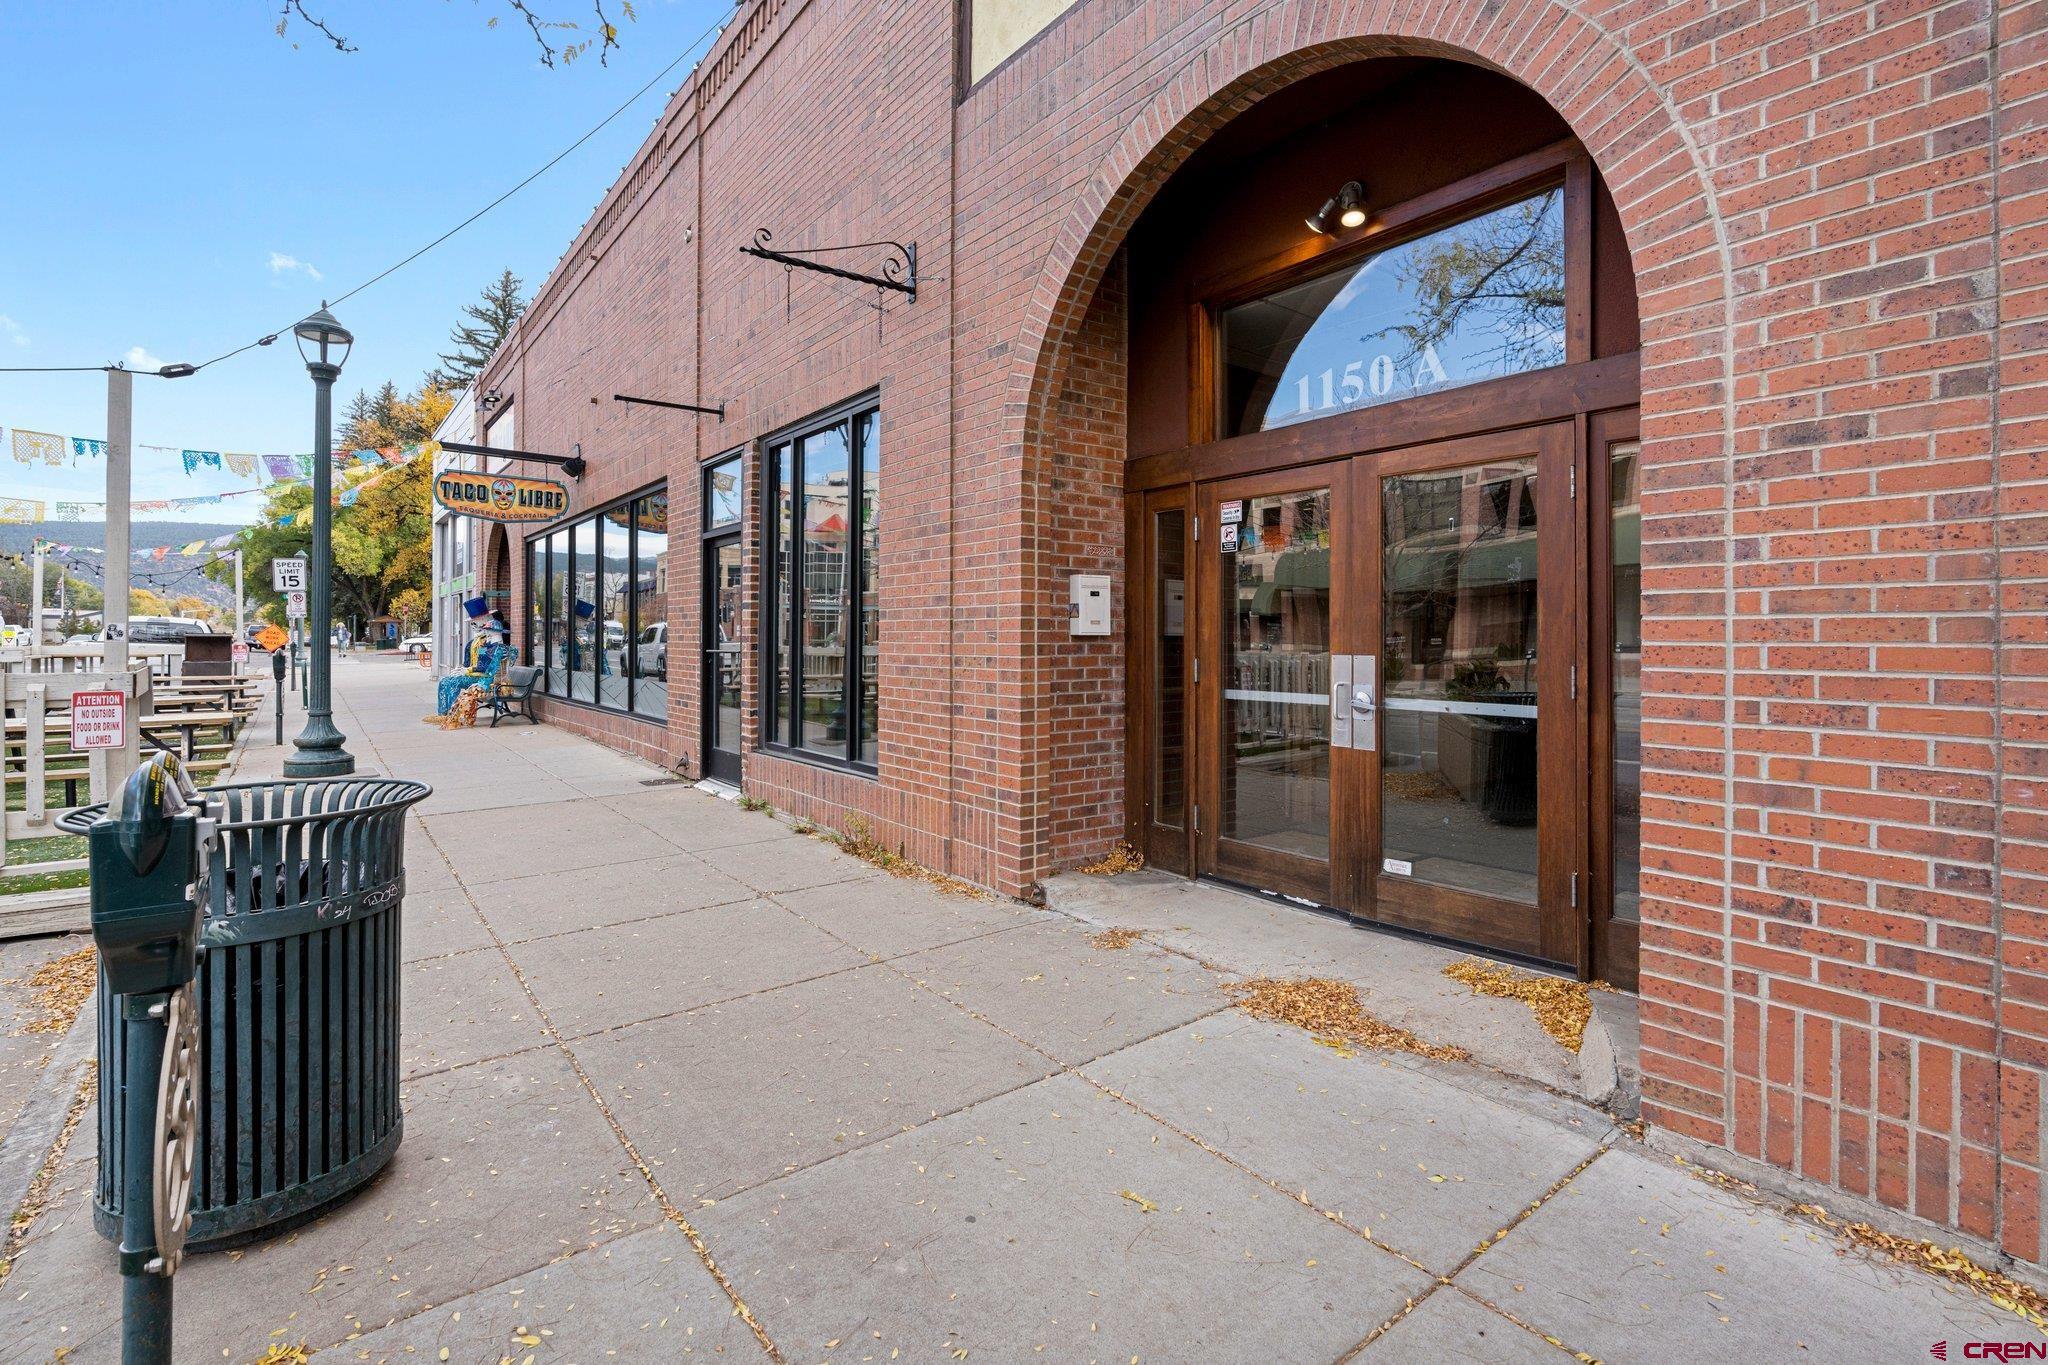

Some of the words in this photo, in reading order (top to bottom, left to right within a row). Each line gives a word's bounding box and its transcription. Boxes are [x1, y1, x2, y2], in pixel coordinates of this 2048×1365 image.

[1294, 354, 1394, 415] 1150
[1410, 341, 1451, 388] A
[440, 480, 489, 503] TACO
[518, 488, 563, 509] LIBRE
[459, 506, 498, 518] TAQUERIA
[501, 512, 508, 520] &
[281, 575, 300, 587] 15
[76, 694, 120, 706] ATTENTION
[81, 709, 89, 718] NO
[91, 708, 115, 718] OUTSIDE
[76, 722, 91, 732] FOOD
[94, 722, 101, 731] OR
[103, 721, 120, 731] DRINK
[85, 734, 112, 745] ALLOWED
